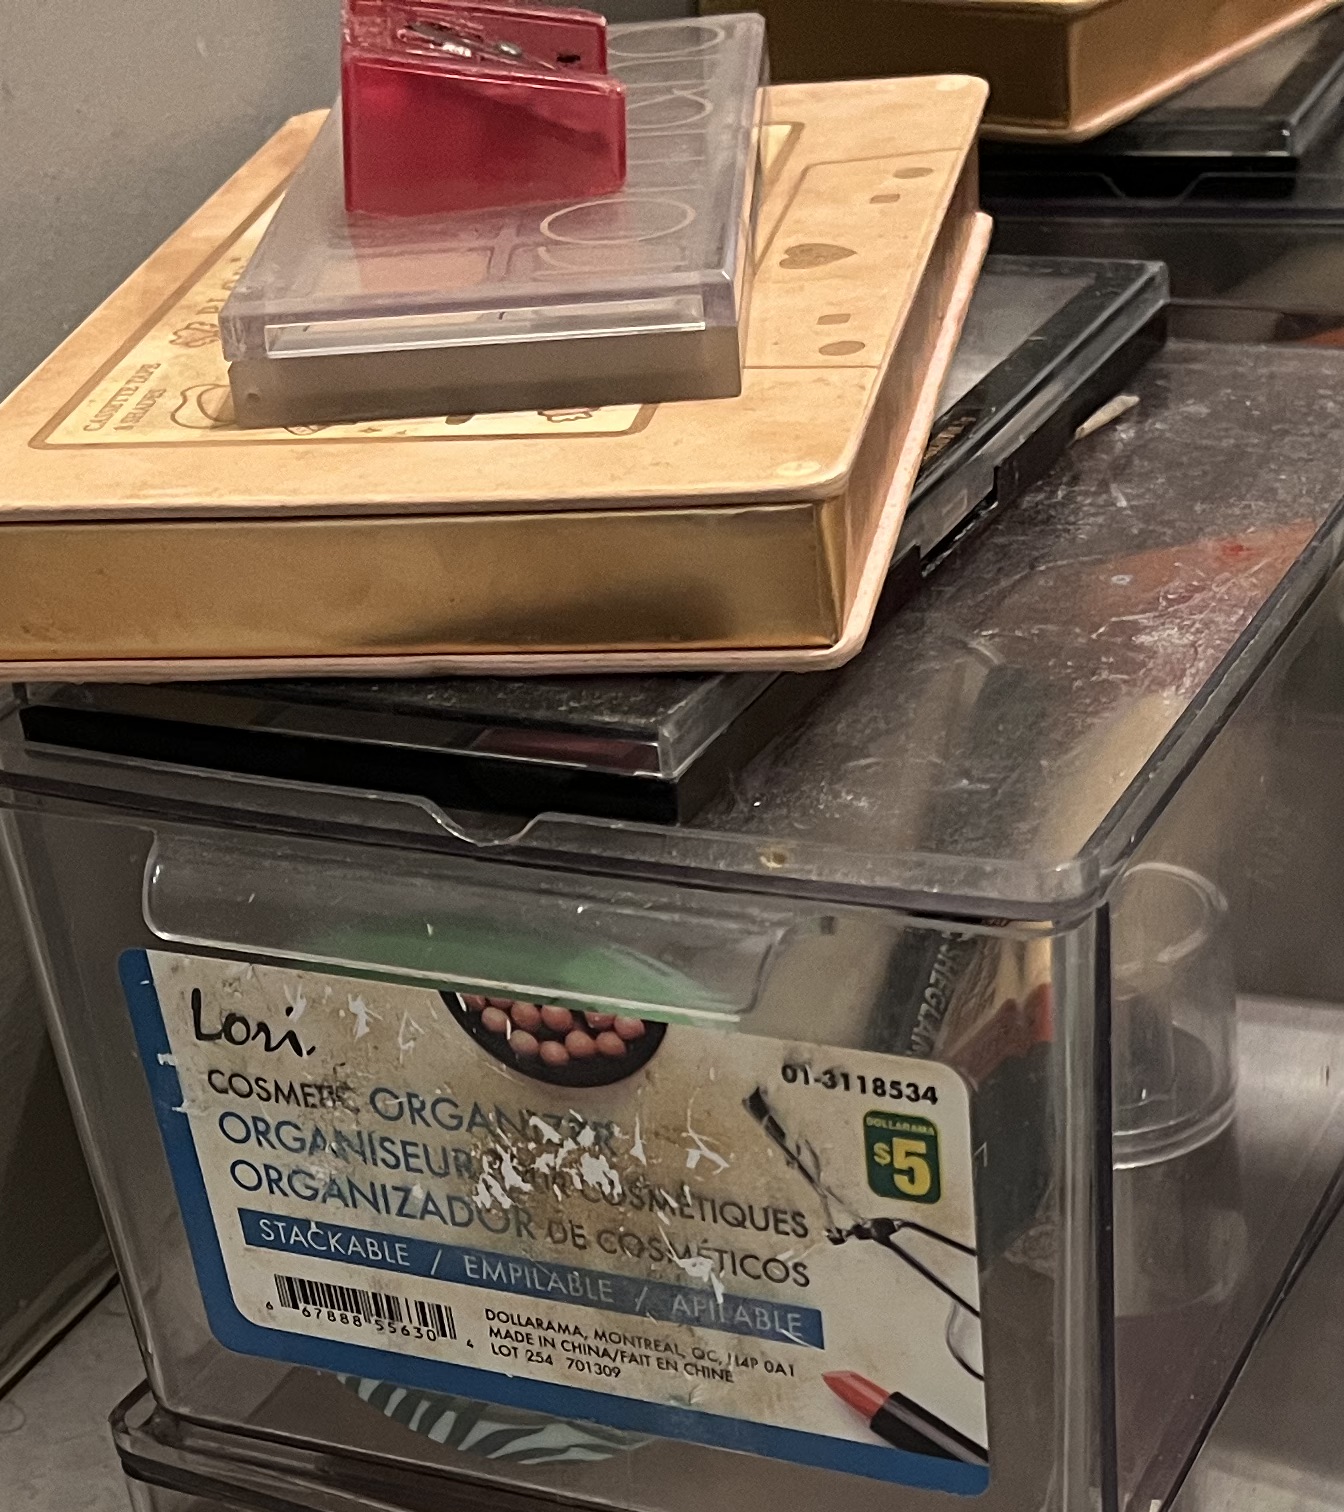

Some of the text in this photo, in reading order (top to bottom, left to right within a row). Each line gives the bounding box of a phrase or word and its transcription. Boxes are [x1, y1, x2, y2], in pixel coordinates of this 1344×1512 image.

[781, 1064, 939, 1105] 01-3118534
[873, 1137, 932, 1197] $5
[230, 1159, 536, 1240] ORGANIZADOR
[547, 1219, 588, 1250] DE
[259, 1218, 411, 1267] STACKABLE
[464, 1254, 615, 1304] EMPILABLE
[671, 1294, 804, 1338] APILABLE
[489, 1326, 735, 1384] MADE IN CHINA/FAIT EN CHINE
[491, 1342, 622, 1379] LOT 254 701309
